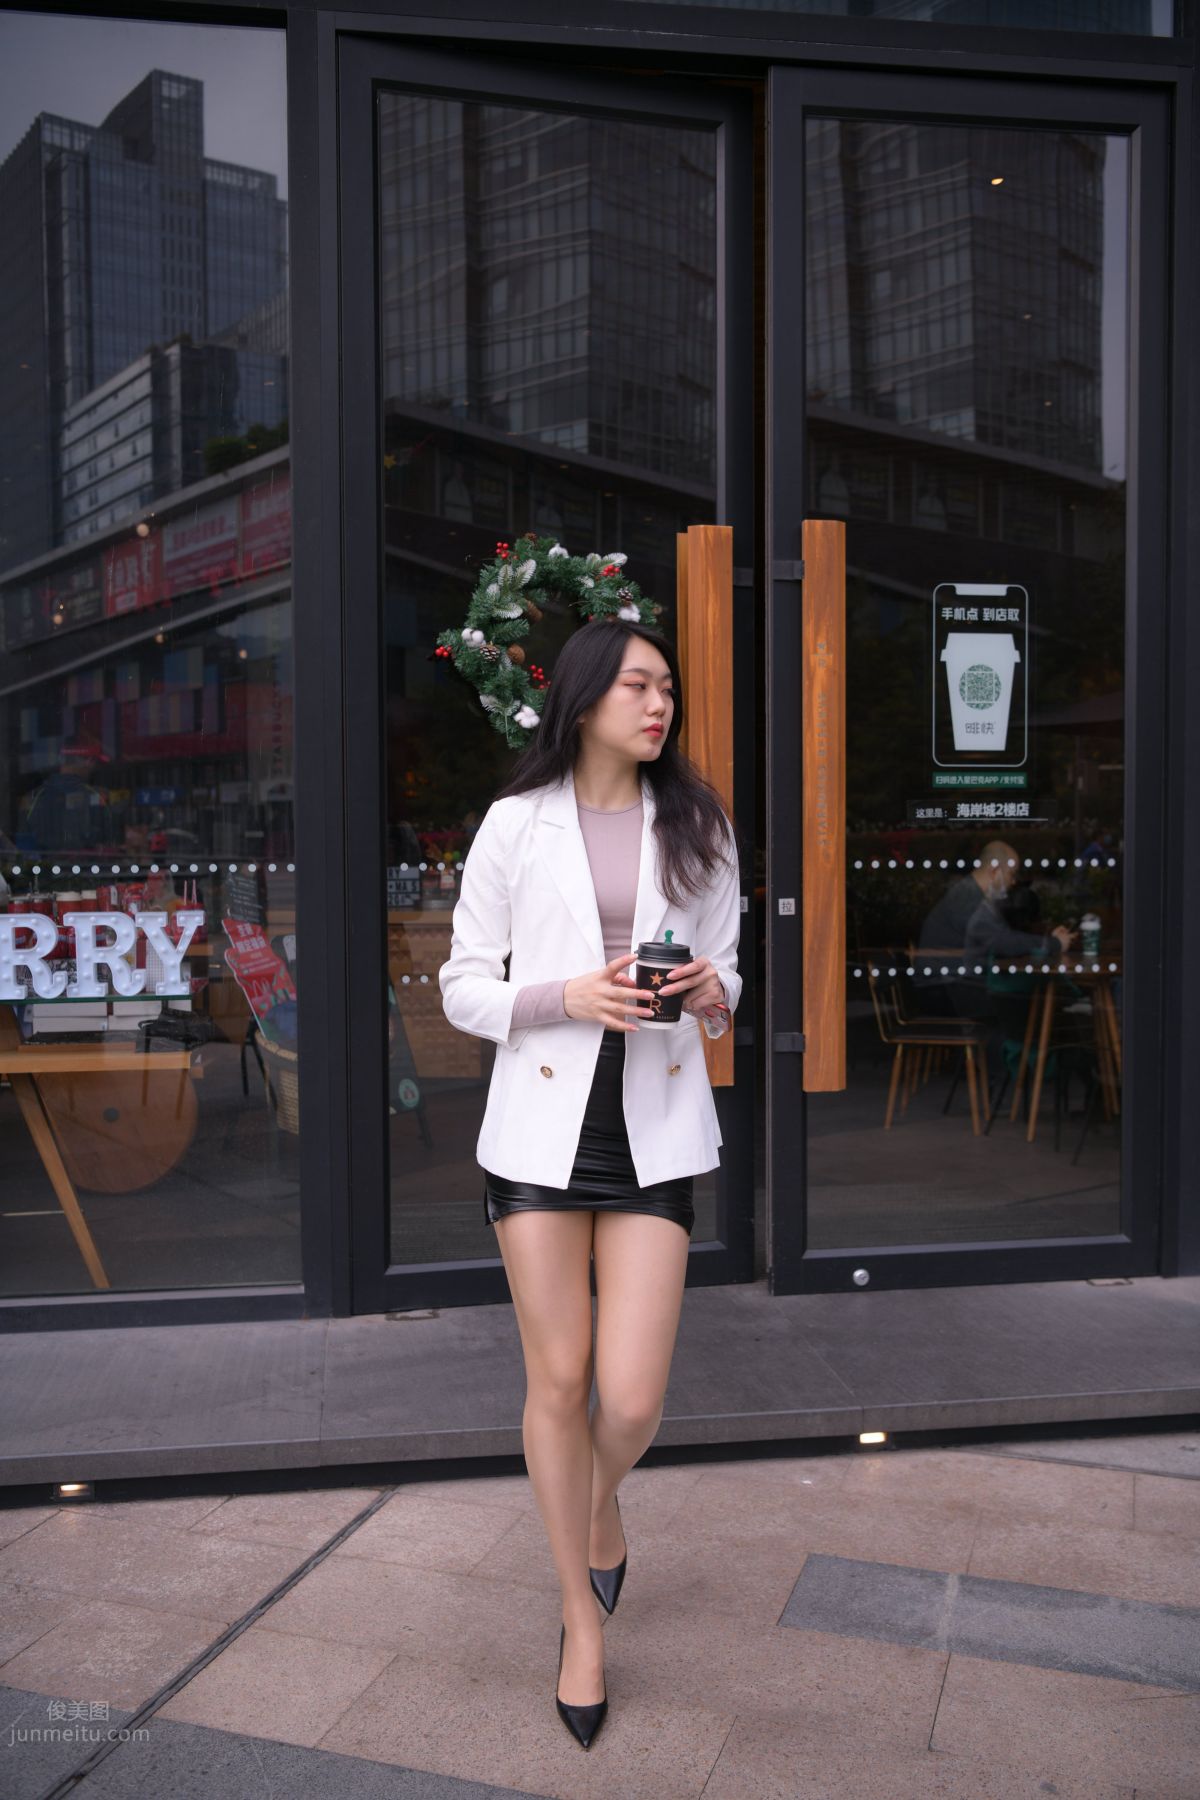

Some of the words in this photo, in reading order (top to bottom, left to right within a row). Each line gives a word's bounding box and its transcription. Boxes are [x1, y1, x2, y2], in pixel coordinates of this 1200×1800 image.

[941, 607, 978, 621] 手机点
[982, 607, 1020, 622] 到店取
[964, 722, 995, 735] 啡快
[956, 802, 1030, 818] 海岸城2楼店
[0, 909, 206, 999] RRY
